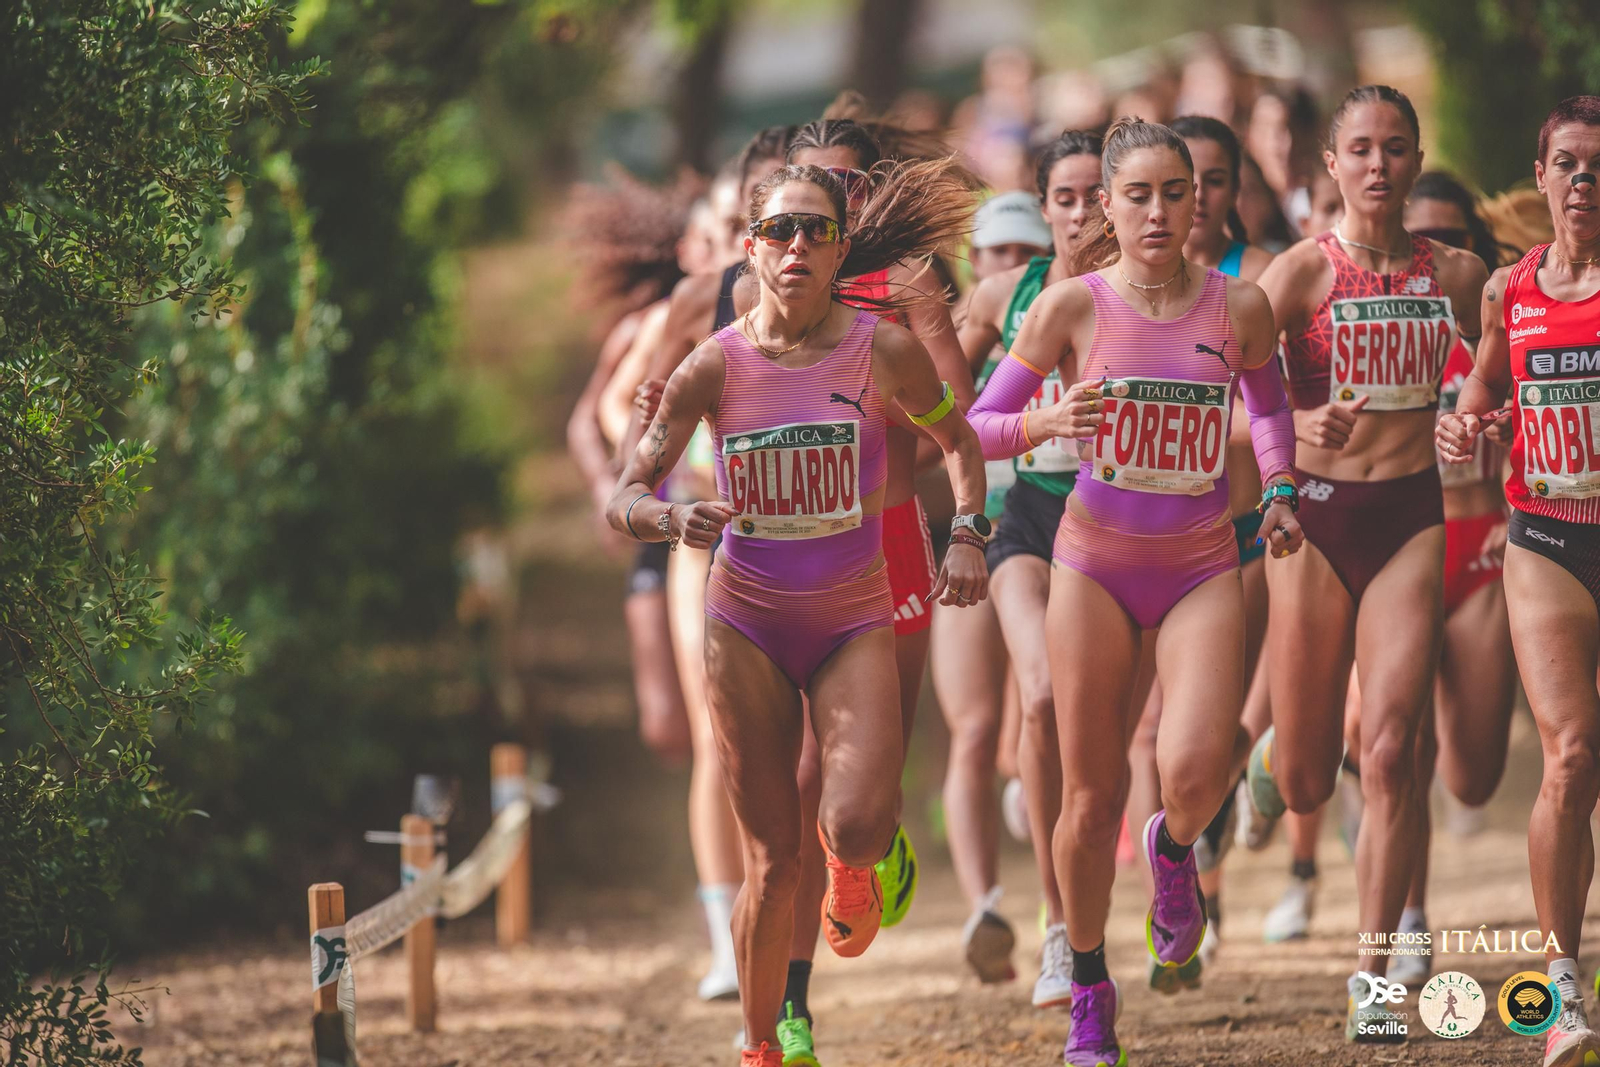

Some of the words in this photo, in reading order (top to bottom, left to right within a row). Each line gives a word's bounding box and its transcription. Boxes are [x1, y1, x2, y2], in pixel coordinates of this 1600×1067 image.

[1367, 301, 1422, 317] ITÁLICA
[1513, 306, 1546, 320] Bilbao
[1335, 320, 1451, 386] SERRANO
[1138, 383, 1196, 400] ITÁLICA
[1096, 399, 1222, 473] FORERO
[729, 445, 854, 515] GALLARDO
